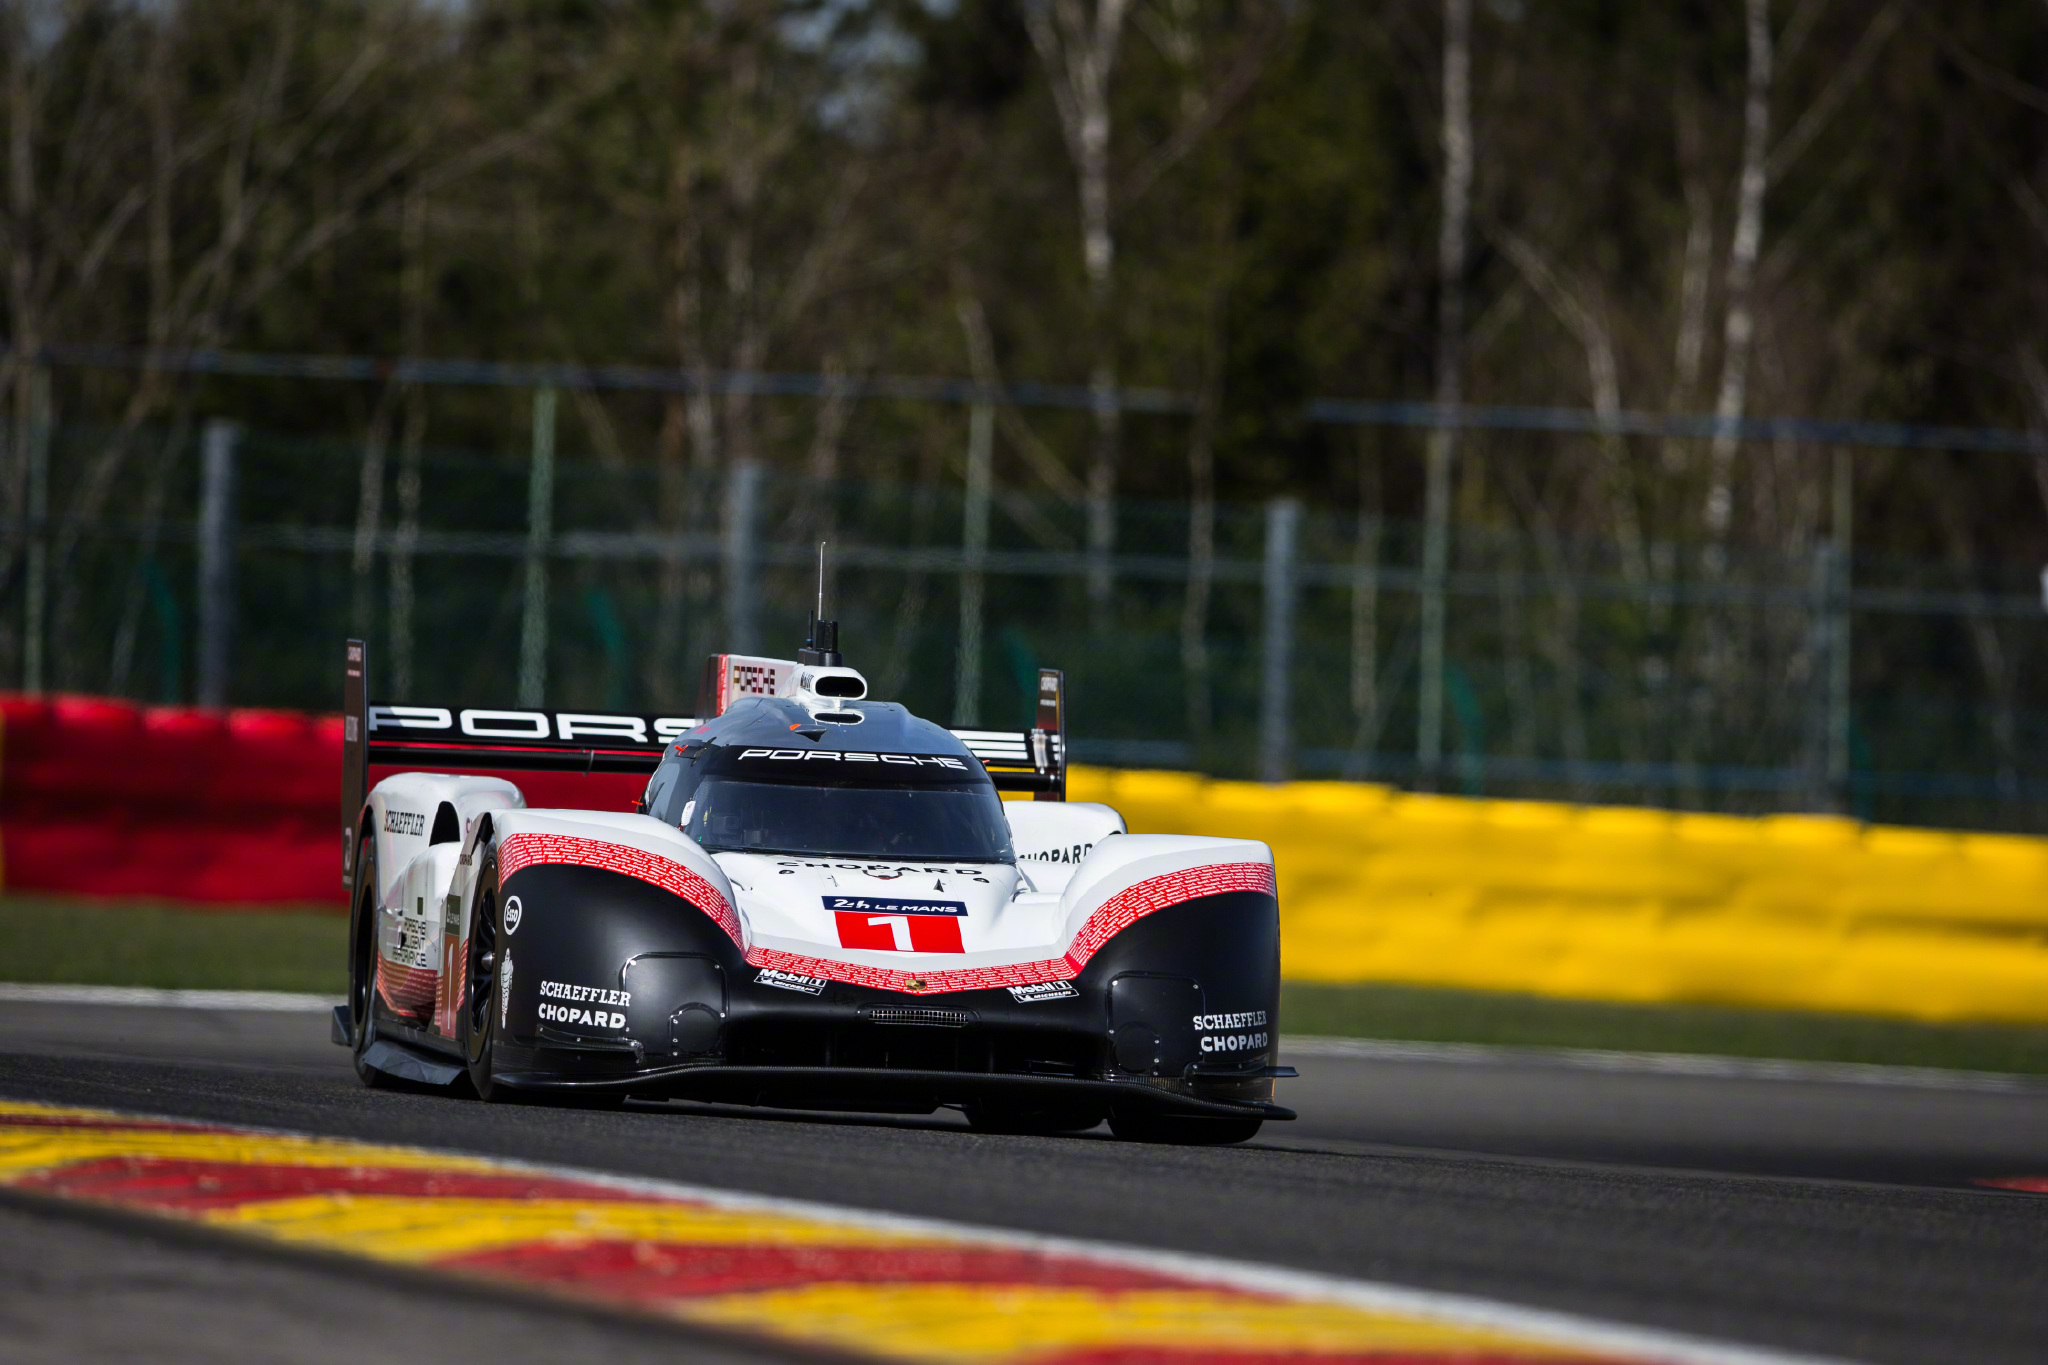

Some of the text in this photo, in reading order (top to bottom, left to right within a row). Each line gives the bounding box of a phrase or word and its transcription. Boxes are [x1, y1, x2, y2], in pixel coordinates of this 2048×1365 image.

[738, 749, 969, 771] PORSCHE
[384, 810, 425, 836] SCHAEFFLER
[1019, 843, 1093, 864] OPARD
[777, 861, 983, 875] CHOPARD
[901, 905, 958, 913] MANS
[867, 916, 915, 951] 1
[759, 968, 809, 985] Mobil
[540, 980, 632, 1007] SCHAEFFLER
[1006, 982, 1056, 995] Mobil
[1033, 990, 1072, 999] MICHELIN
[538, 1002, 626, 1029] CHOPARD
[1193, 1010, 1267, 1031] SCHAEFFLER
[1201, 1032, 1268, 1052] CHOPARD
